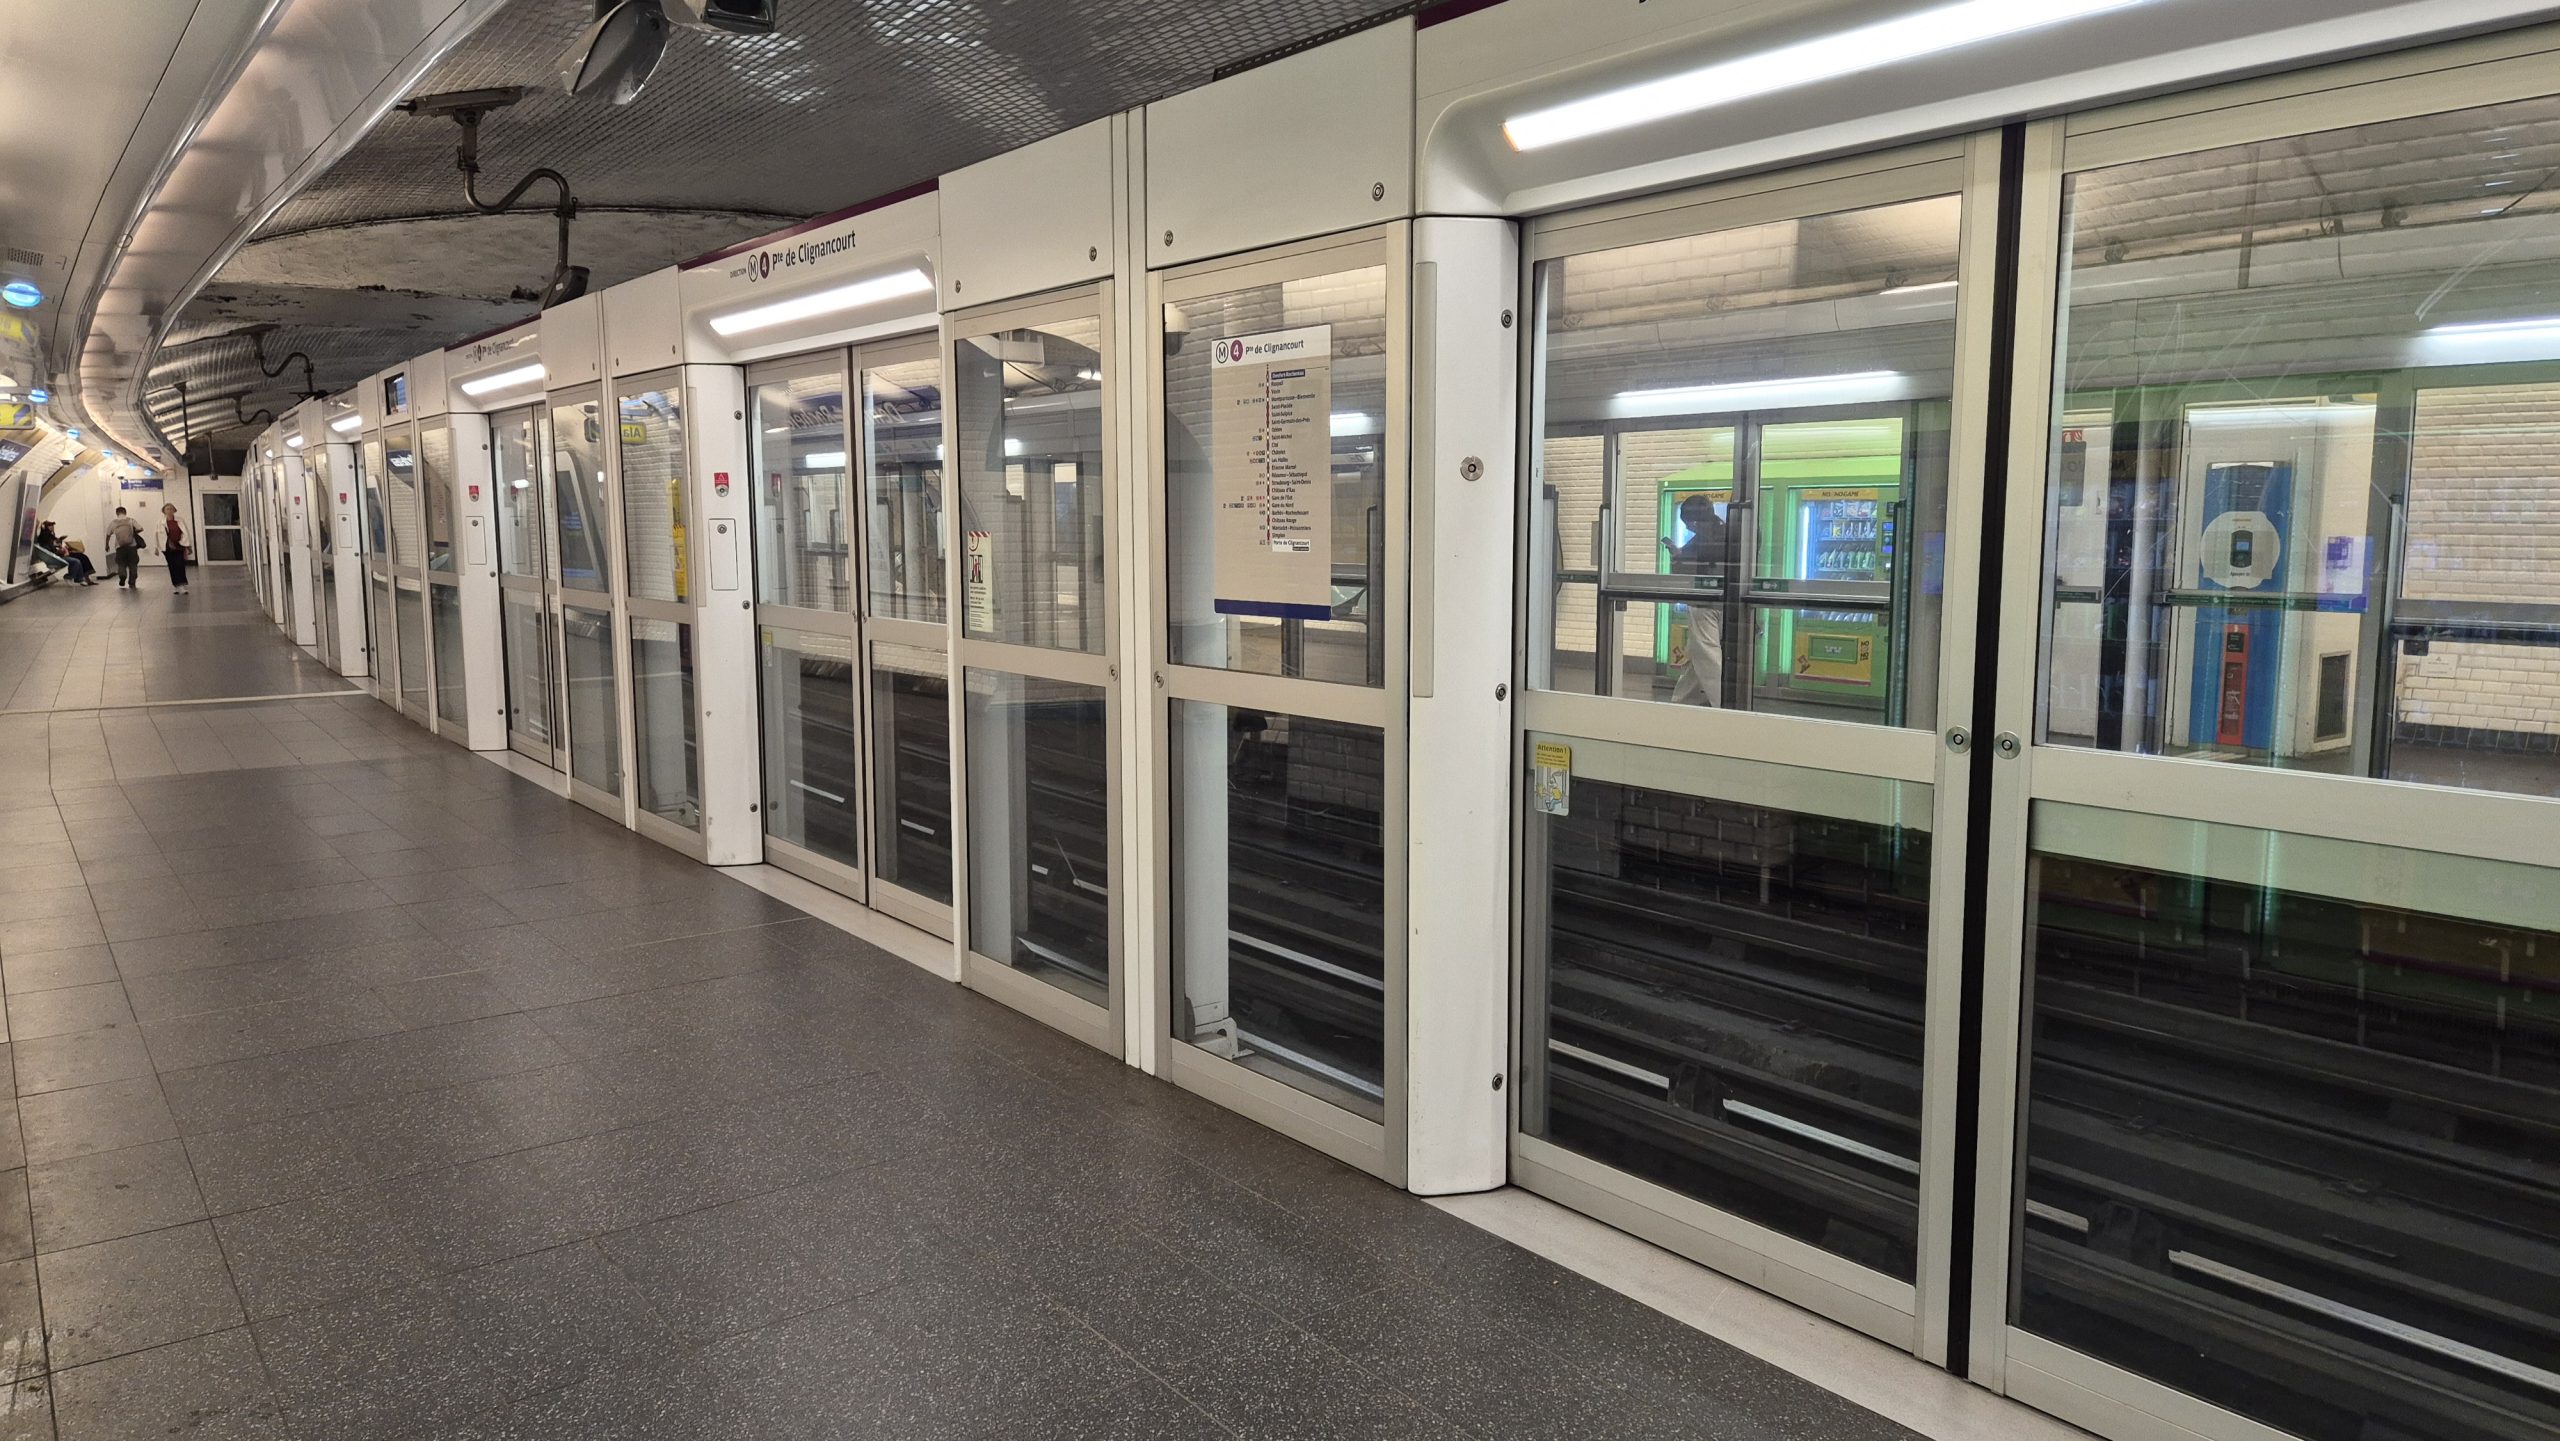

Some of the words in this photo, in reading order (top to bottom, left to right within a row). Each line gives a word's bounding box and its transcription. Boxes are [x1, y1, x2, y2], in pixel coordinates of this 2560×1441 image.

[785, 247, 796, 267] de
[798, 230, 856, 265] Clignancourt
[1254, 344, 1262, 354] de
[1263, 339, 1304, 354] Clignancourt
[1537, 743, 1564, 754] Attention
